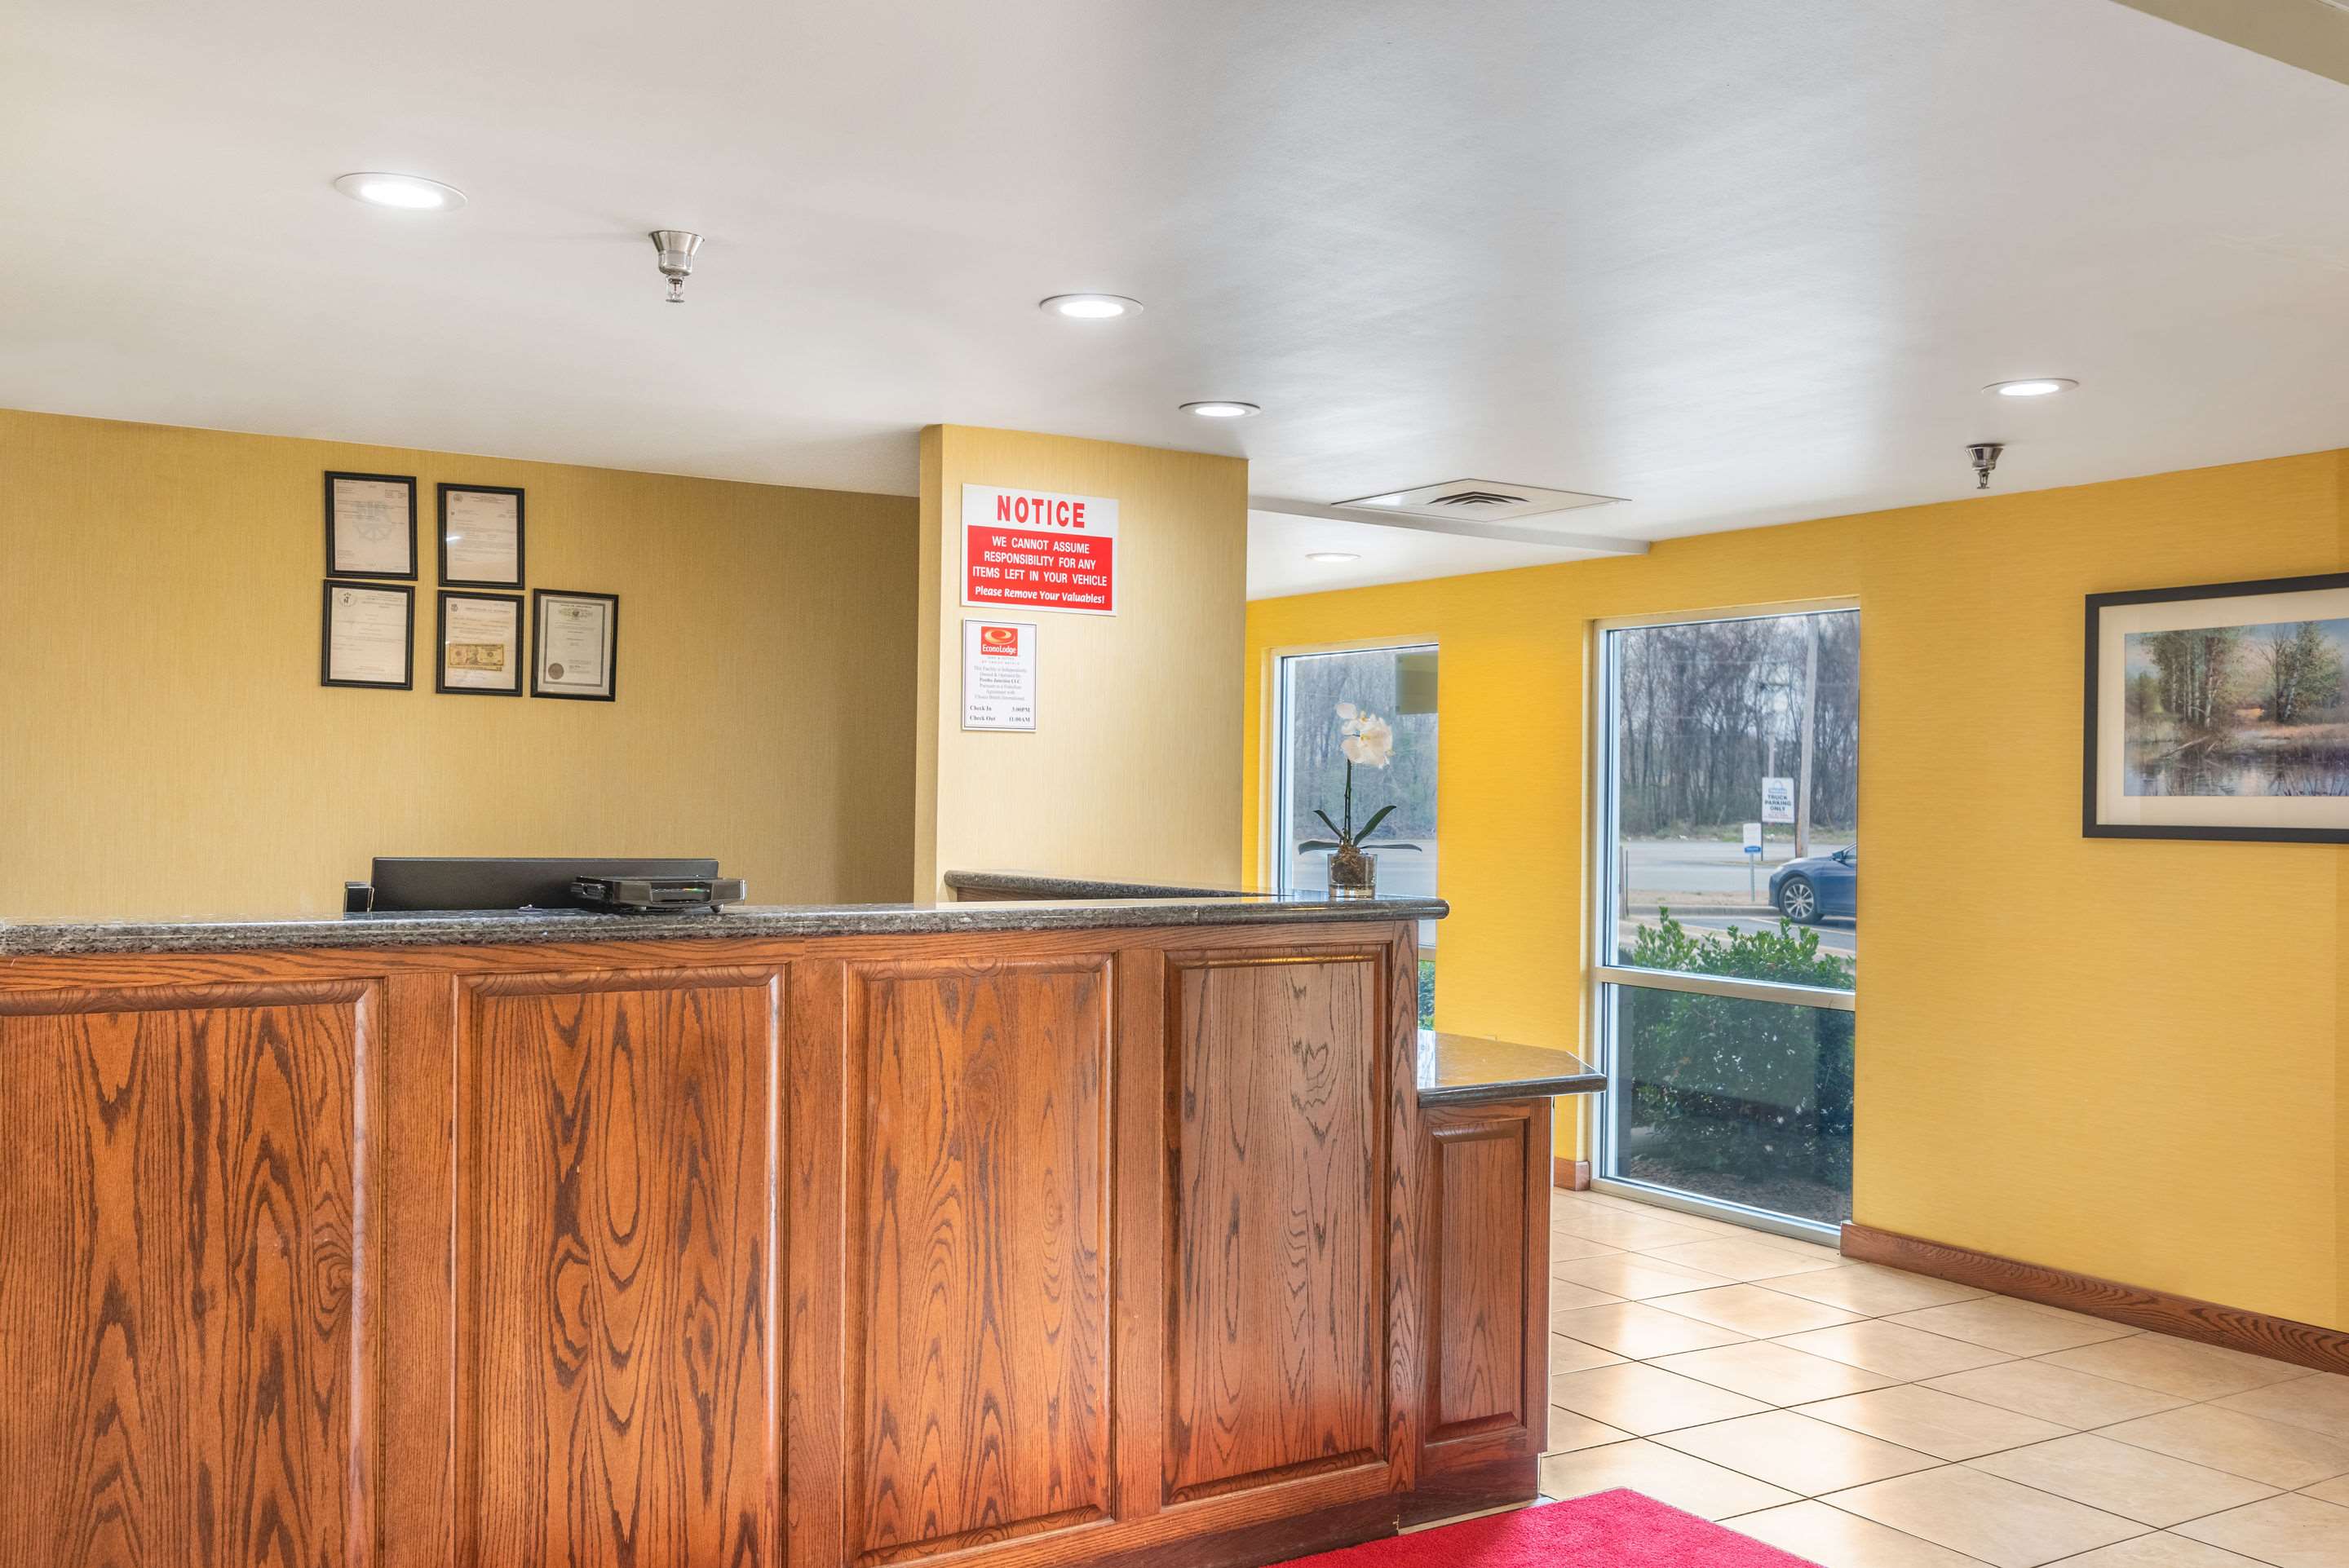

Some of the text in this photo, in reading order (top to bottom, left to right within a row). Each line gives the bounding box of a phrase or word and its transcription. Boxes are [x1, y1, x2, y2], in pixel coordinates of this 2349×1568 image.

[997, 495, 1086, 528] NOTICE
[992, 536, 1090, 554] WE CANNOT ASSUME
[984, 551, 1096, 570] RESPONSIBILITY FOR ANY
[972, 566, 1108, 587] ITEMS LEFT IN YOUR VEHICLE
[975, 586, 1106, 604] Please Remove Your Valuables!
